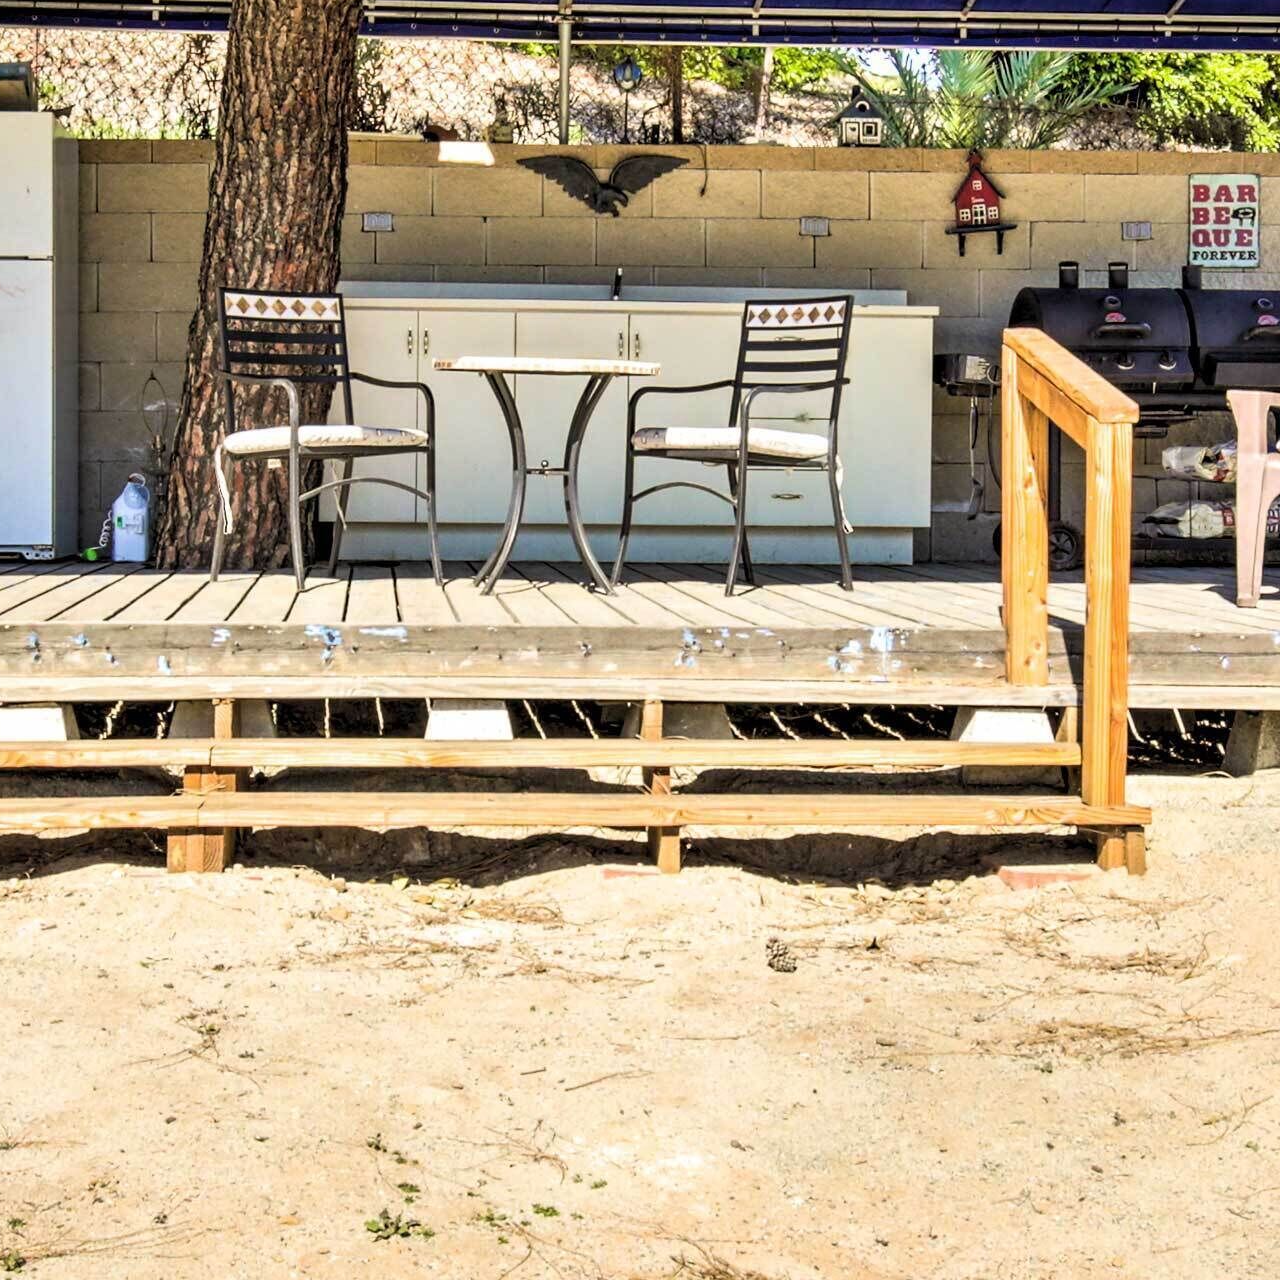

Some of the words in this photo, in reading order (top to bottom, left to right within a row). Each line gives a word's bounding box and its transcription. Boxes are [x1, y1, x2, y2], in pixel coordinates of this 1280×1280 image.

[1192, 184, 1257, 202] BAR
[1192, 207, 1231, 225] BE
[1192, 228, 1253, 248] QUE
[1192, 251, 1257, 261] FOREVER
